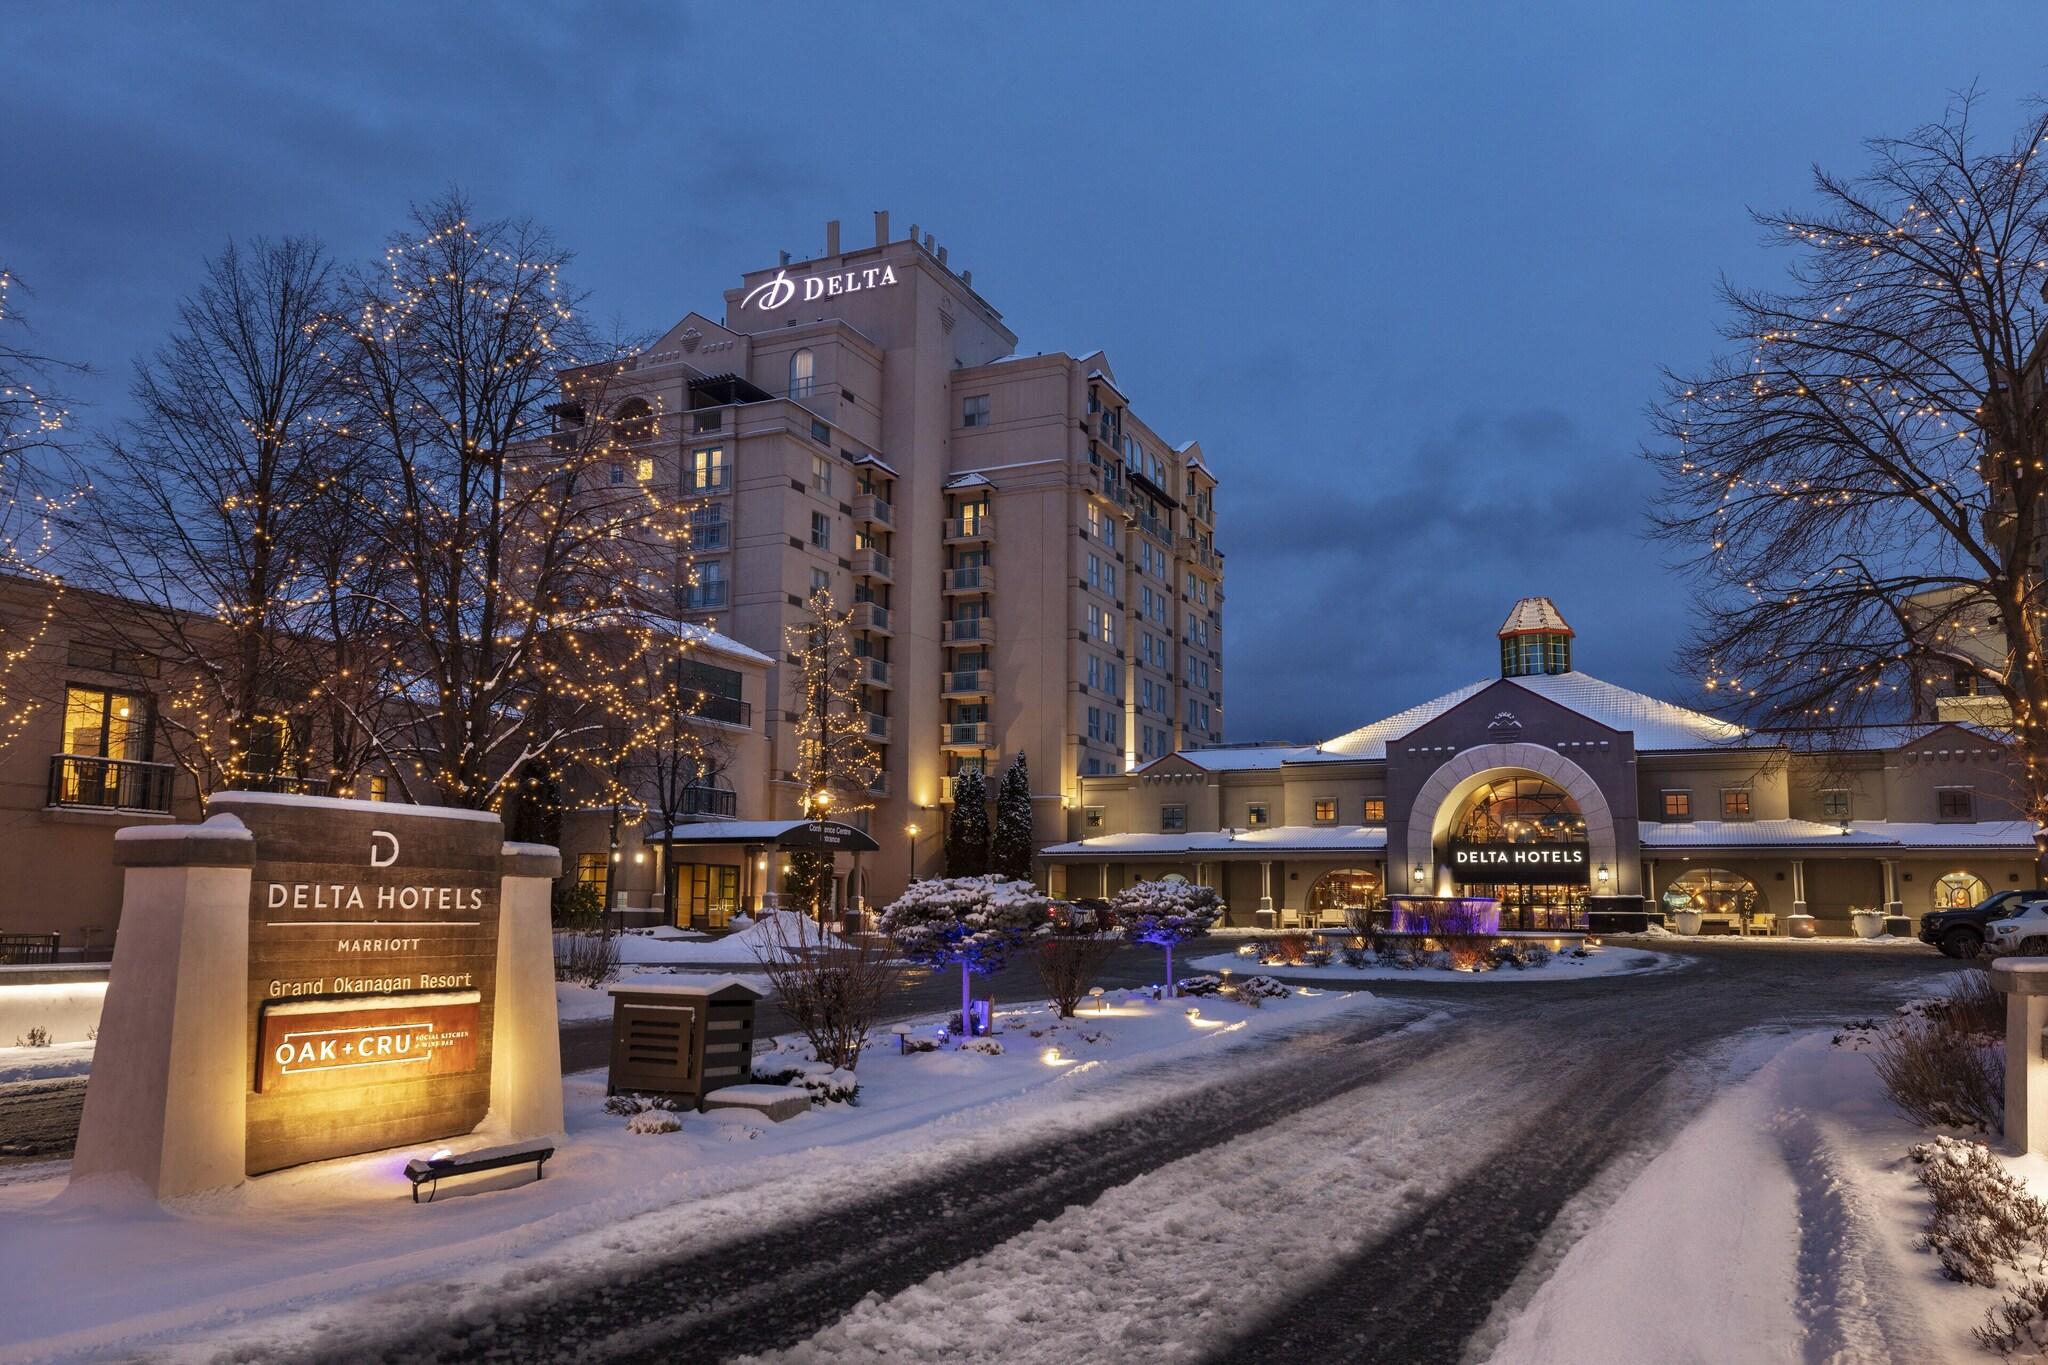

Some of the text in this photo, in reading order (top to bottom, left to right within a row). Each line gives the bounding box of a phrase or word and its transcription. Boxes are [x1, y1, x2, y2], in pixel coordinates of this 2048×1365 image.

[803, 264, 898, 302] DELTA
[809, 823, 851, 836] Confence Centre
[1456, 850, 1583, 863] DELTA HOTELS
[268, 883, 483, 910] DELTA HOTELS
[337, 938, 421, 953] MARRIOTT
[269, 972, 472, 998] Grand Okanagan Resort
[441, 1031, 469, 1039] KITCHEN
